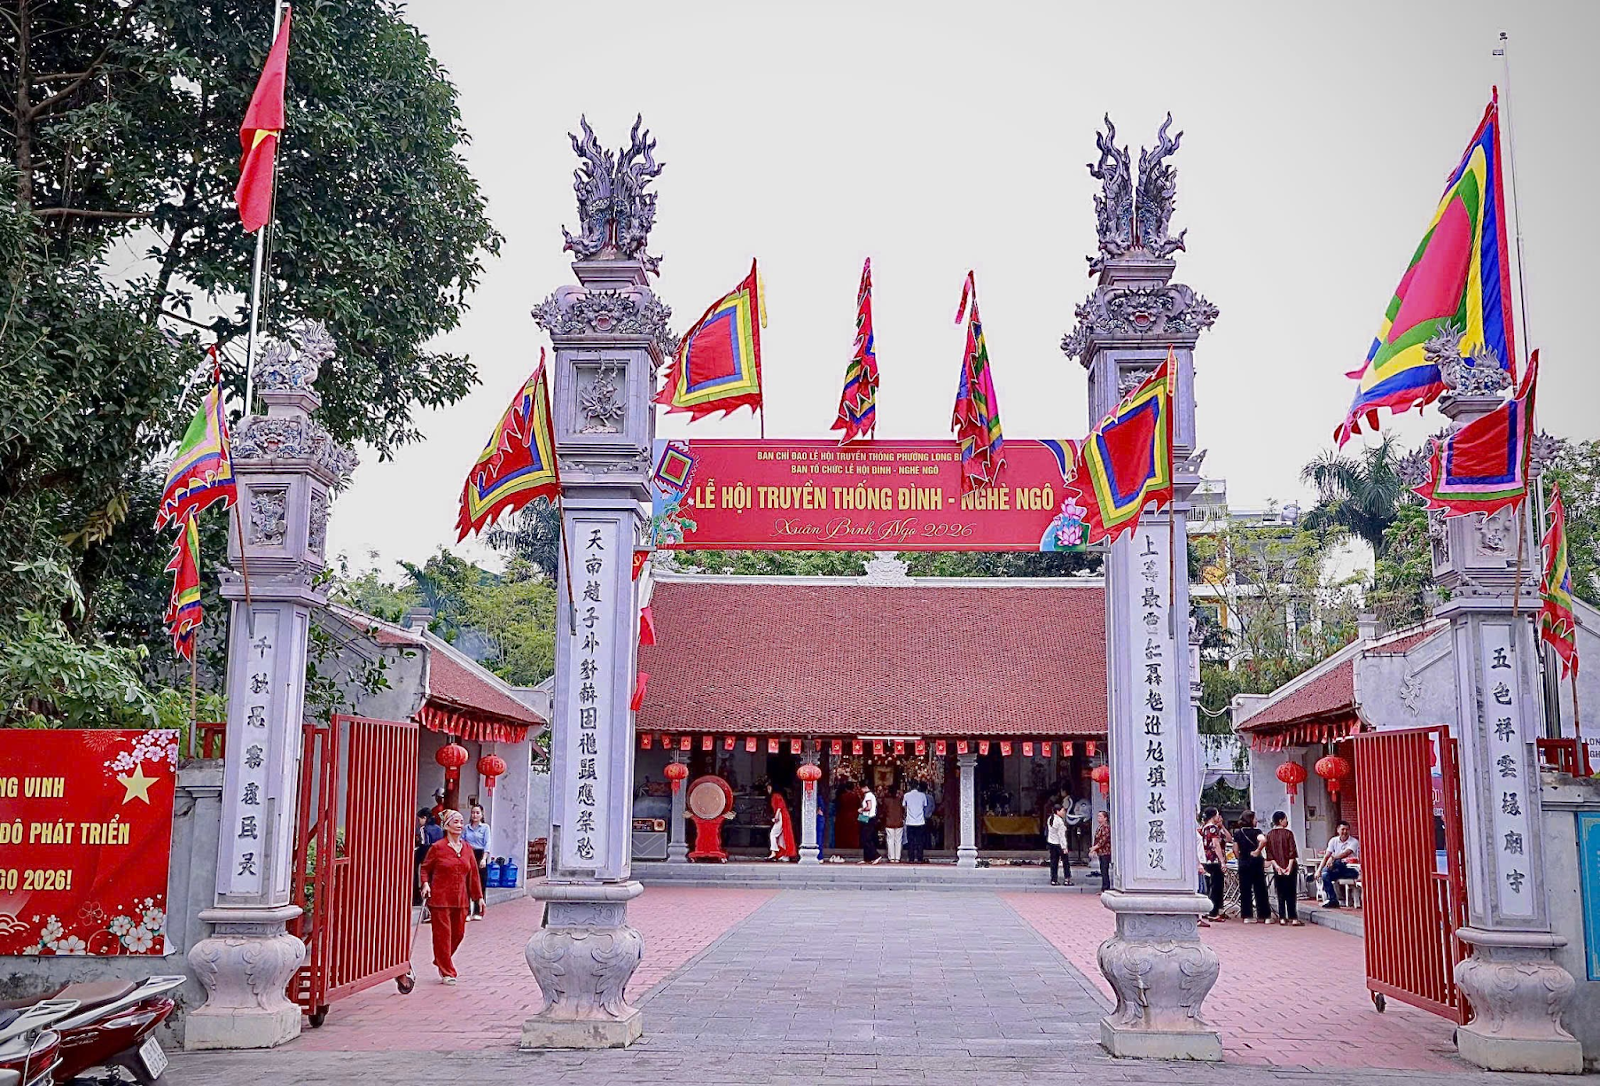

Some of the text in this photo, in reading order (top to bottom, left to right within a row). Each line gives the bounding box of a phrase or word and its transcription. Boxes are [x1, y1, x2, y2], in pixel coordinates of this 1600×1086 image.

[757, 451, 774, 460] BAN
[791, 451, 808, 462] ĐẠO
[820, 451, 834, 462] HỘI
[836, 450, 867, 461] TRUYỀN
[868, 450, 895, 461] THỐNG
[896, 451, 929, 461] PHƯỜNG
[931, 453, 952, 461] LONG
[791, 465, 808, 474] BAN
[821, 464, 843, 474] CHỨC
[856, 465, 870, 475] HỘI
[872, 464, 892, 474] ĐÌNH
[898, 465, 920, 475] NGHÈ
[922, 464, 939, 475] NGÔ
[695, 478, 716, 509] LỄ
[721, 481, 752, 514] HỘI
[757, 479, 827, 510] TRUYỀN
[832, 479, 893, 510] THỐNG
[897, 482, 943, 510] ĐÌNH
[961, 482, 1010, 511] NGHÈ
[1016, 482, 1054, 511] NGÔ
[769, 516, 977, 543] Xuân Bính Ngọ 2026
[24, 777, 65, 798] VINH
[0, 813, 130, 845] ĐÔ PHÁT TRIỂN
[22, 869, 73, 891] 2026!
